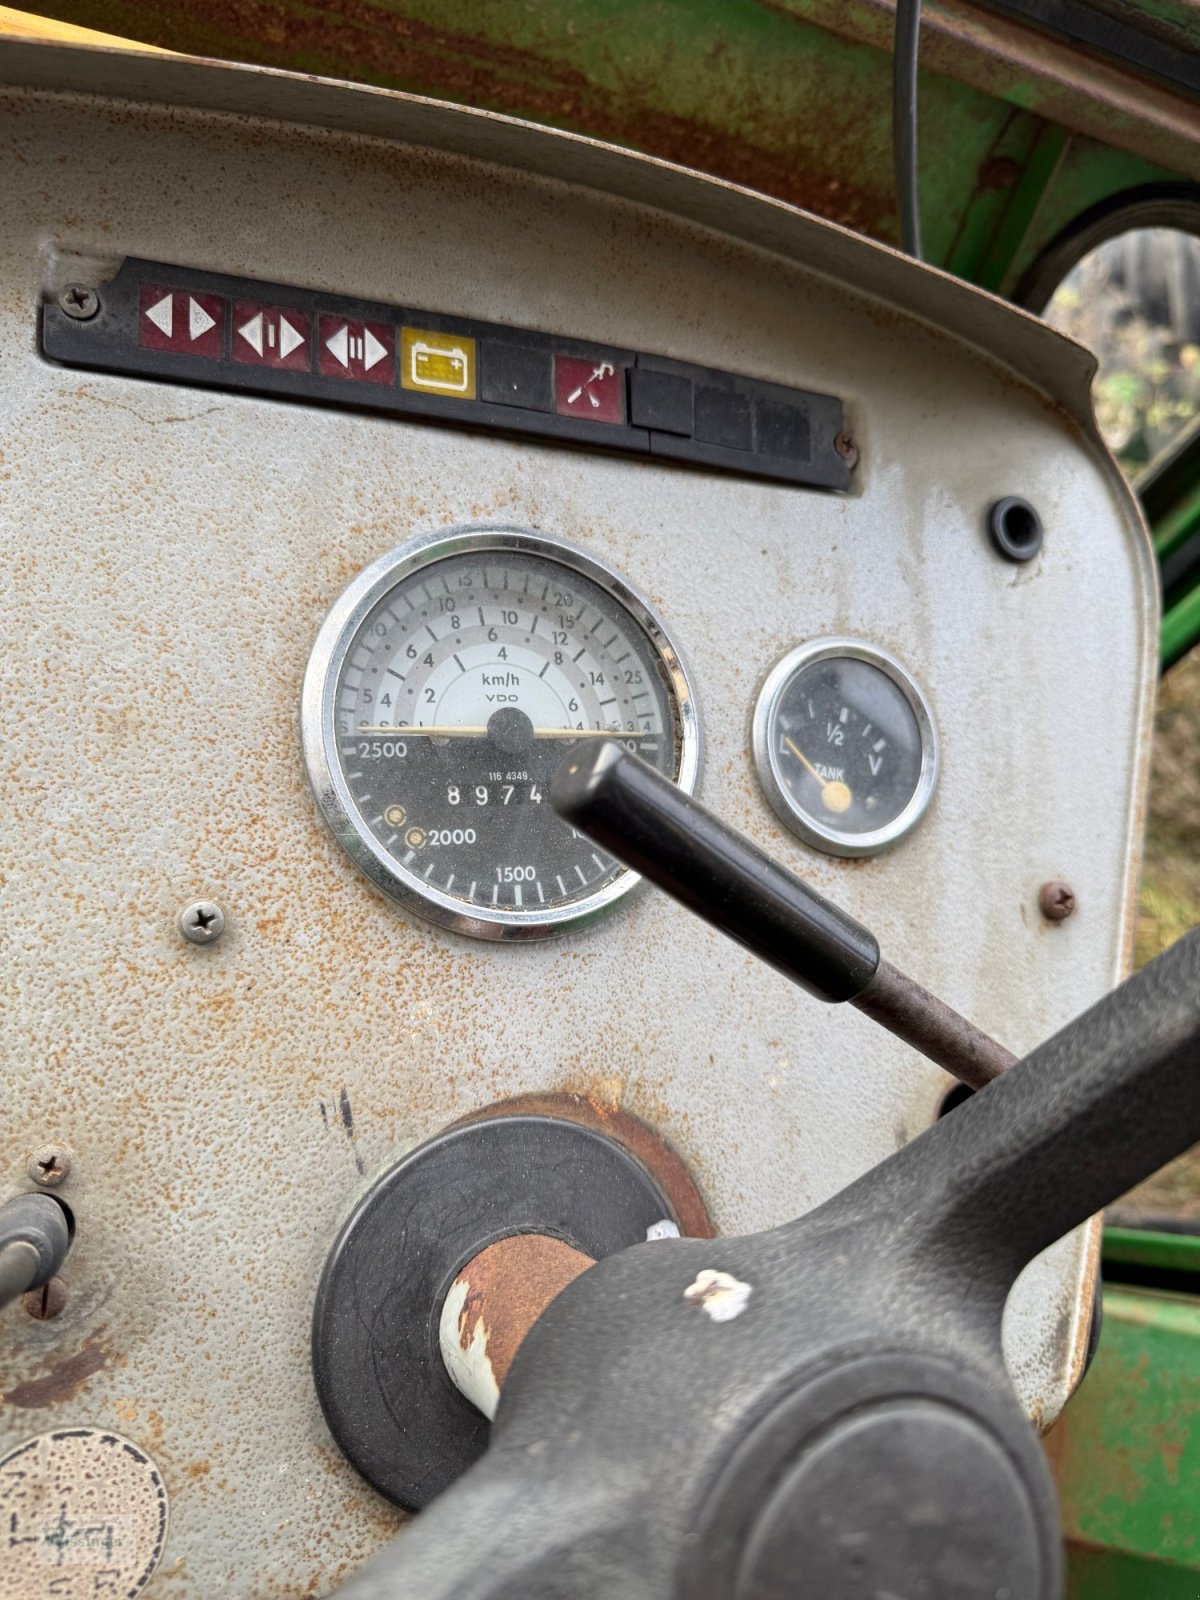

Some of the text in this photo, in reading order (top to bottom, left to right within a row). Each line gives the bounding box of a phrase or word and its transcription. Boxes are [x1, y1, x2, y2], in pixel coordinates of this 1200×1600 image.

[439, 597, 457, 612] 10
[555, 592, 574, 607] 20
[451, 615, 461, 629] 8
[501, 610, 518, 625] 10
[559, 614, 575, 629] 15
[487, 627, 498, 642] 6
[552, 631, 569, 646] 12
[406, 644, 418, 659] 6
[497, 646, 508, 660] 4
[554, 651, 563, 665] 8
[423, 653, 435, 668] 4
[482, 671, 520, 688] km/h
[589, 671, 605, 686] 14
[624, 670, 642, 685] 25
[362, 688, 373, 704] 5
[380, 692, 392, 708] 4
[424, 688, 436, 704] 2
[485, 694, 518, 703] VDO
[568, 697, 578, 712] 6
[627, 721, 635, 732] 3
[643, 721, 651, 732] 4
[359, 742, 408, 759] 2500
[779, 734, 790, 755] L
[814, 763, 845, 781] TANK
[868, 755, 883, 776] V
[428, 828, 477, 846] 2000
[495, 866, 536, 883] 1500
